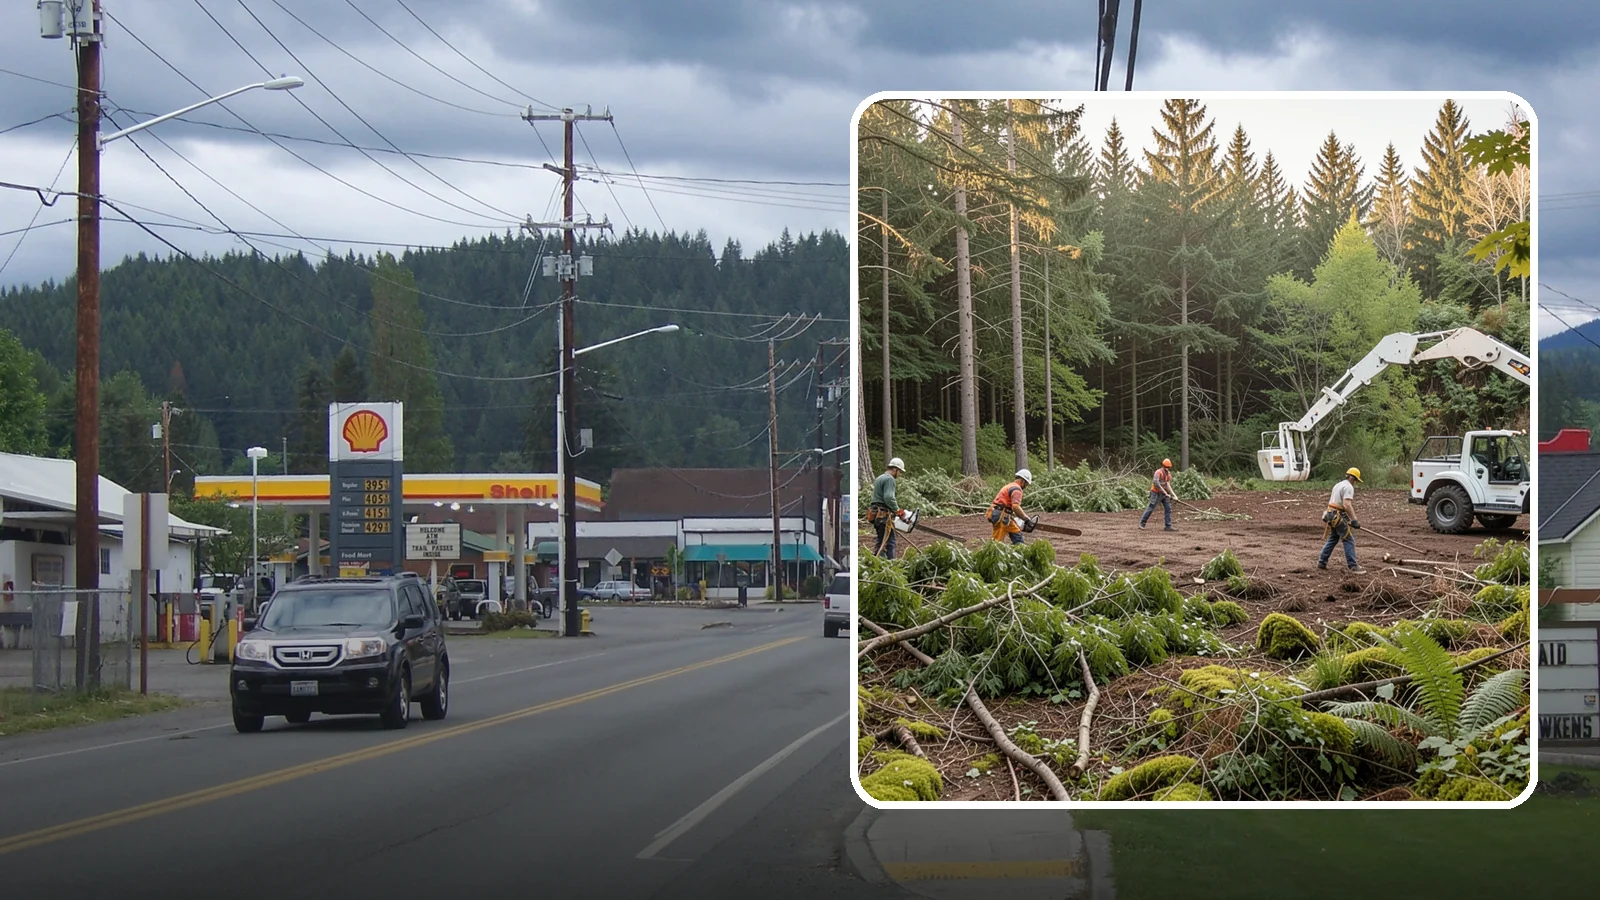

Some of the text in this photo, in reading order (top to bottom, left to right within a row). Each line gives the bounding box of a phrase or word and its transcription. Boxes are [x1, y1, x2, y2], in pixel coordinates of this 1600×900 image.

[365, 480, 383, 490] 395
[490, 484, 547, 499] Shell
[365, 494, 383, 504] 405
[365, 508, 383, 518] 415
[365, 522, 383, 532] 429
